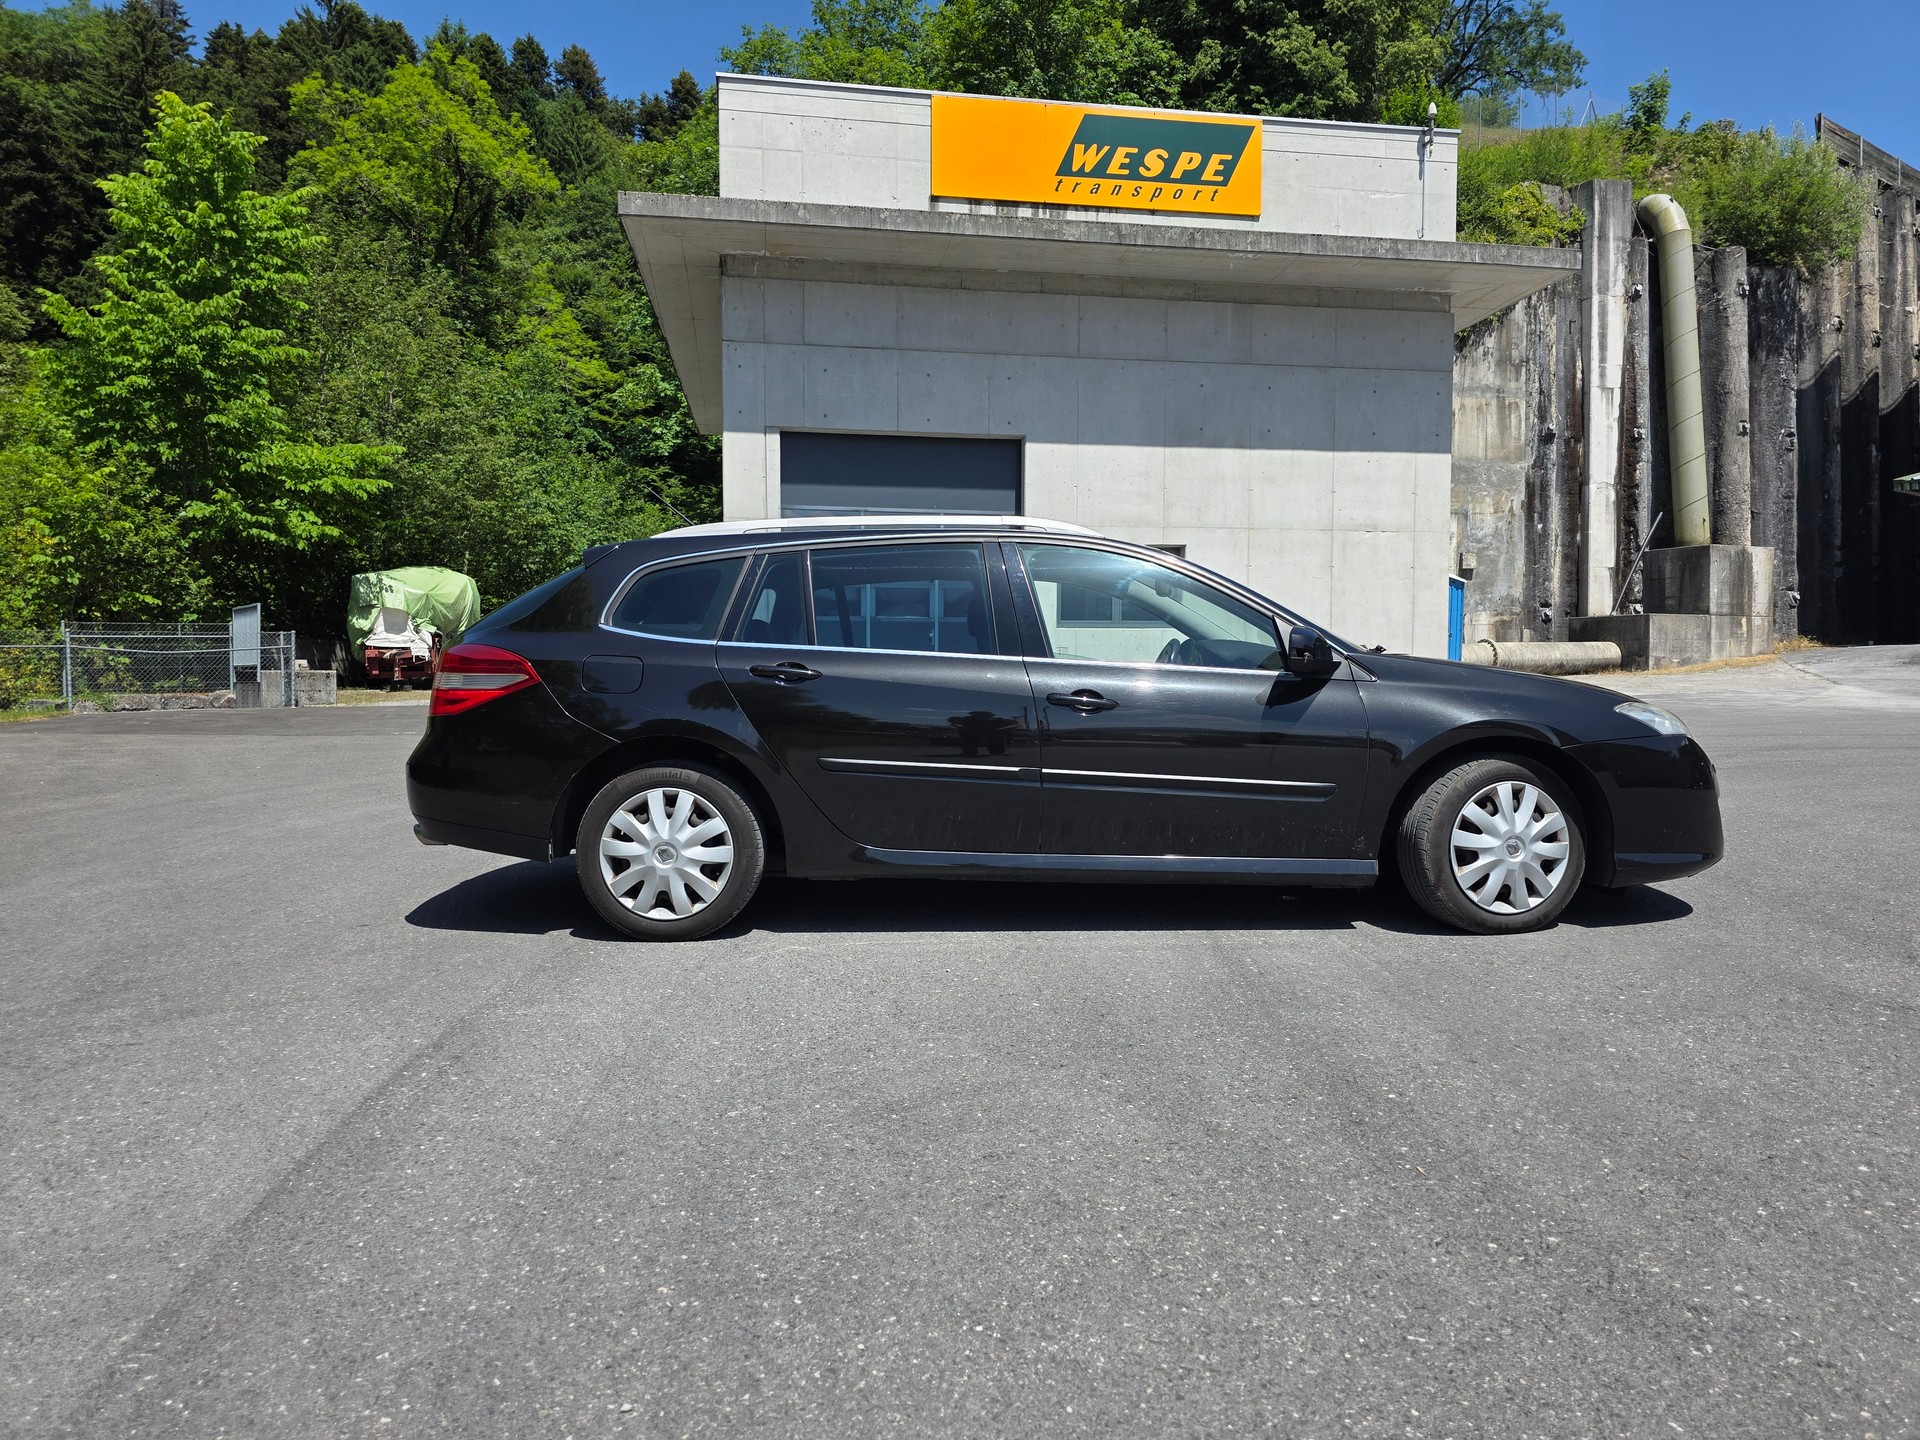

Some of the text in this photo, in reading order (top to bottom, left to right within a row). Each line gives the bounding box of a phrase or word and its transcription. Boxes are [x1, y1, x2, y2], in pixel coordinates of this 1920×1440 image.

[1071, 143, 1233, 182] WESPE
[1054, 178, 1219, 203] transport
[624, 770, 683, 789] Continental
